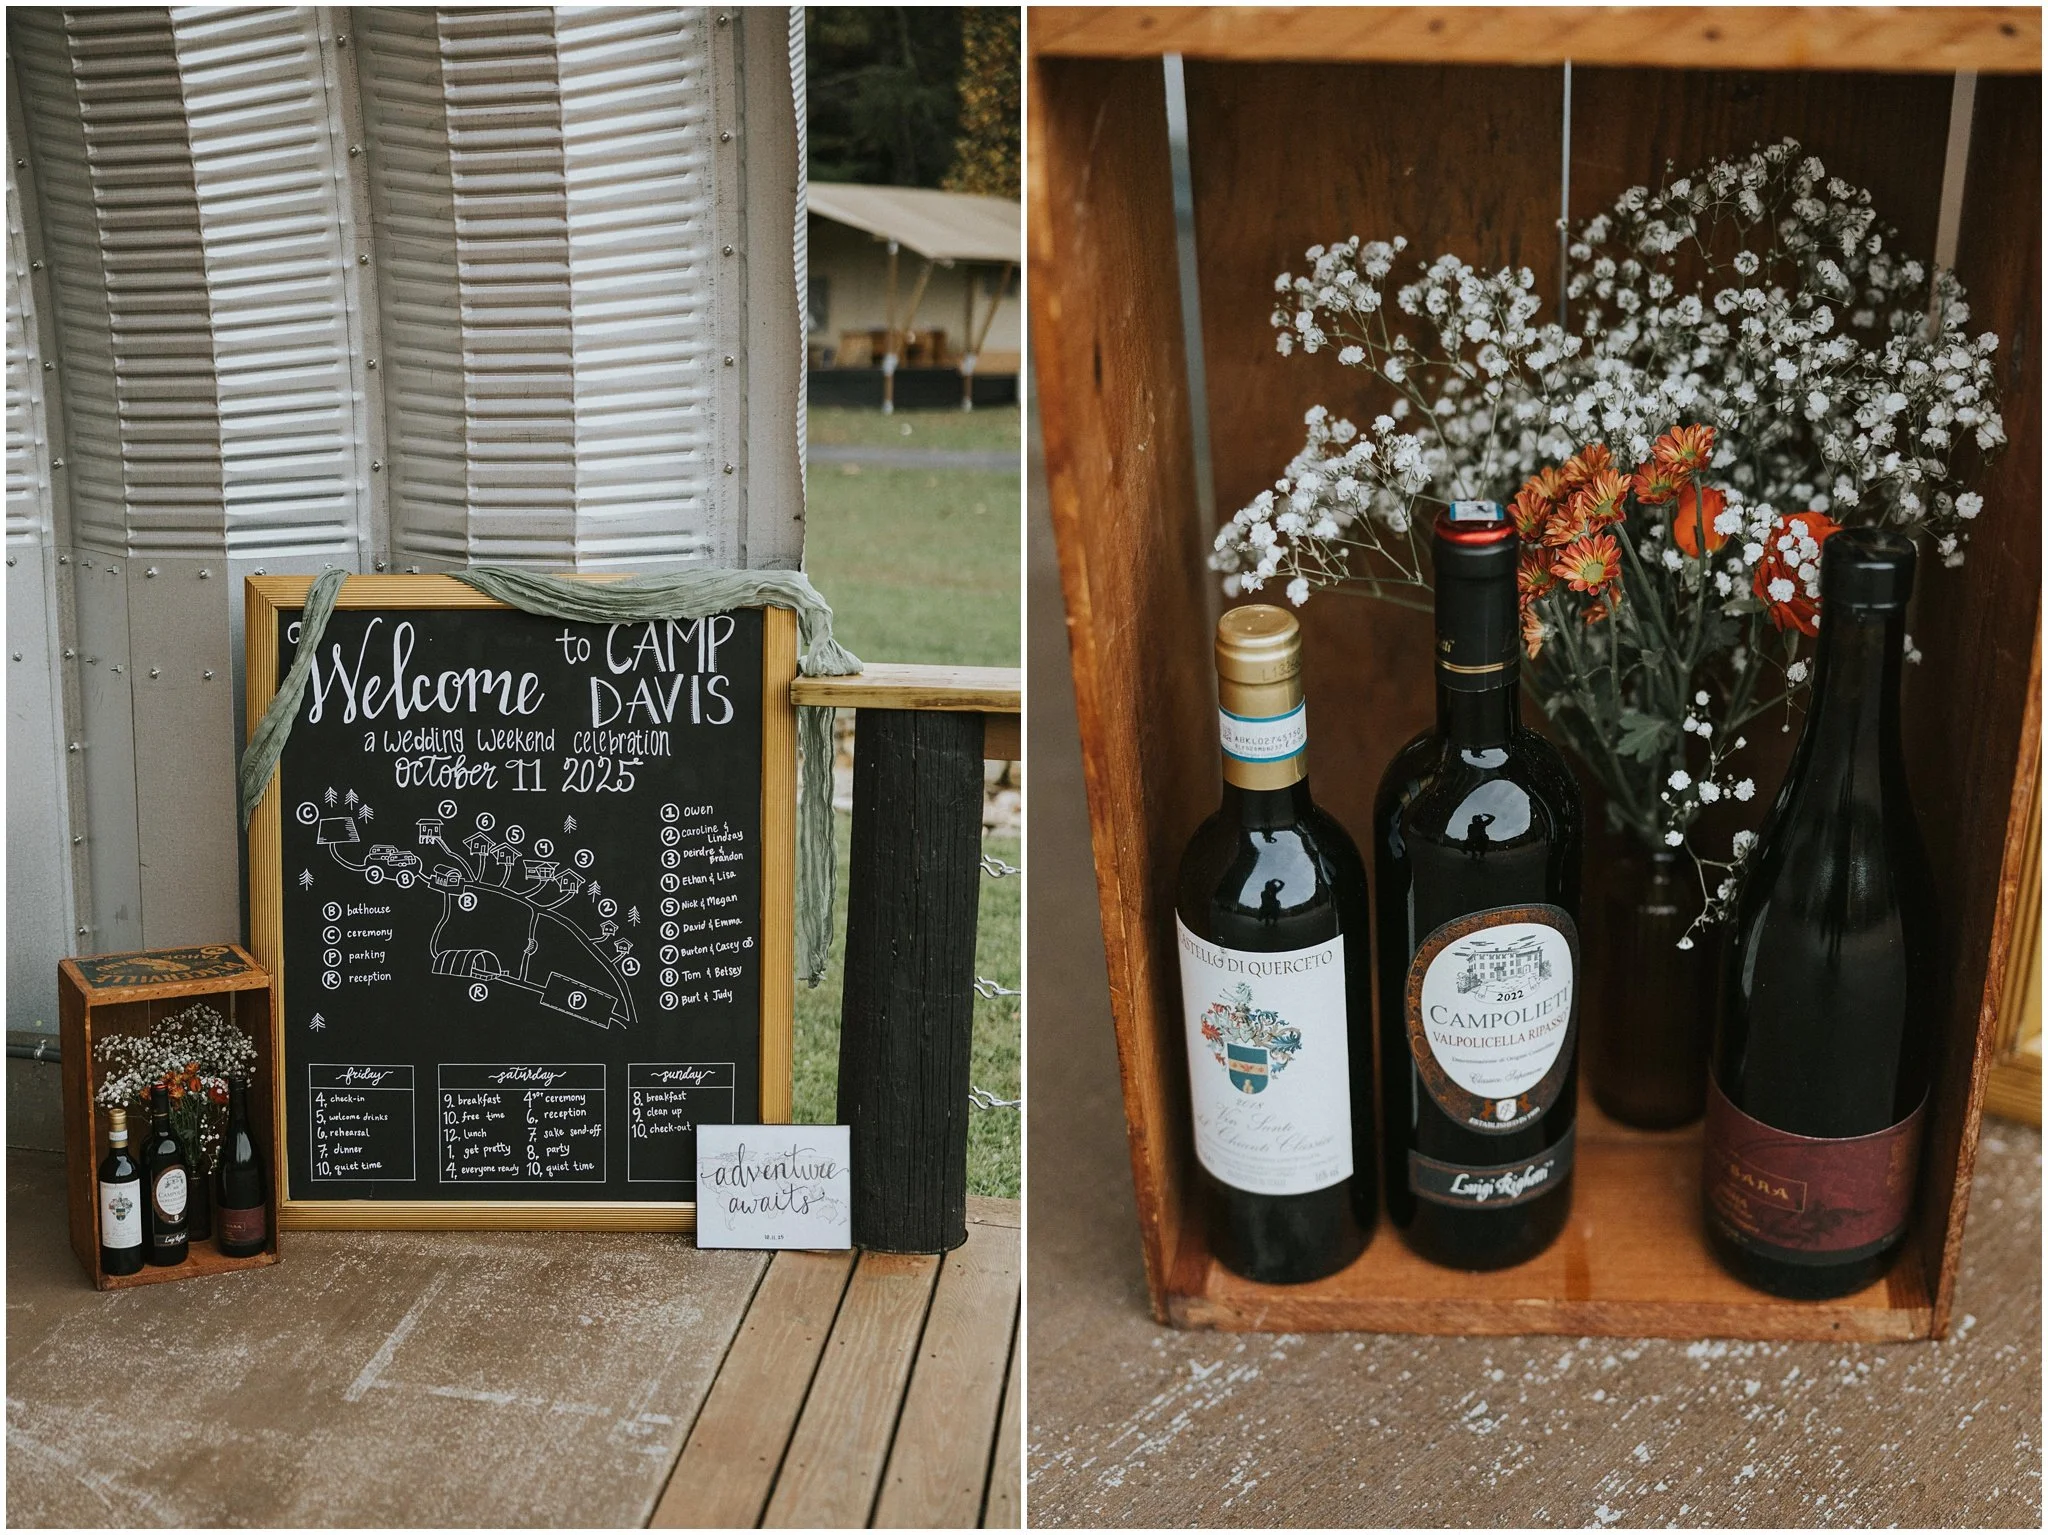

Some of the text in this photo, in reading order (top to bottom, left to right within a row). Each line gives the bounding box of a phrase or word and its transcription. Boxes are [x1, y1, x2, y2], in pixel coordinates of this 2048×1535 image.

[556, 616, 735, 674] to CAMP
[287, 617, 545, 724] Welcome
[591, 675, 734, 729] DAVIS
[365, 728, 671, 757] a wedding weekend celebration
[505, 759, 546, 791] 11
[562, 756, 643, 792] 2025
[706, 830, 743, 843] Lindsay
[684, 846, 716, 859] Deirdre
[709, 851, 743, 864] Brandon
[683, 875, 707, 885] Ethan
[717, 872, 736, 881] Lisa
[682, 900, 698, 910] Nick
[707, 895, 737, 907] Megan
[348, 903, 391, 916] bathouse
[683, 920, 705, 932] David
[715, 918, 742, 927] Emma
[347, 929, 392, 941] ceremony
[681, 946, 707, 956] Burton
[716, 941, 739, 953] Casey
[349, 950, 385, 963] parking
[1228, 958, 1244, 973] DI
[1248, 950, 1333, 978] QUERCETO
[349, 972, 391, 985] reception
[682, 971, 701, 981] Tom
[715, 966, 741, 977] Betsey
[682, 992, 700, 1006] Burt
[713, 989, 732, 1003] Judy
[1496, 990, 1524, 1002] 2022
[1430, 987, 1569, 1030] CAMPOLIETI
[1432, 1011, 1567, 1049] VALPOLICELLA RIPASSO
[336, 1067, 393, 1086] friday
[489, 1067, 566, 1086] saturday
[651, 1067, 715, 1085] sunday
[331, 1094, 364, 1102] check-in
[458, 1094, 501, 1106] breakfast
[545, 1095, 585, 1105] ceremony
[647, 1091, 686, 1102] breakfast
[462, 1112, 479, 1122] free
[486, 1112, 505, 1121] time
[544, 1108, 586, 1119] reception
[647, 1107, 667, 1116] clean
[672, 1109, 682, 1118] up
[330, 1128, 369, 1136] rehearsal
[544, 1128, 564, 1138] sake
[570, 1124, 601, 1136] send-off
[650, 1121, 691, 1133] check-out
[464, 1129, 486, 1139] lunch
[334, 1143, 362, 1154] dinner
[464, 1145, 479, 1159] get
[484, 1142, 510, 1157] pretty
[546, 1143, 569, 1156] party
[335, 1162, 358, 1175] quiet
[462, 1166, 495, 1176] everyone
[498, 1164, 519, 1175] ready
[546, 1161, 569, 1177] quiet
[573, 1161, 594, 1171] time
[700, 1143, 849, 1188] adventure
[1450, 1173, 1495, 1202] Luigi
[729, 1183, 825, 1215] awaits
